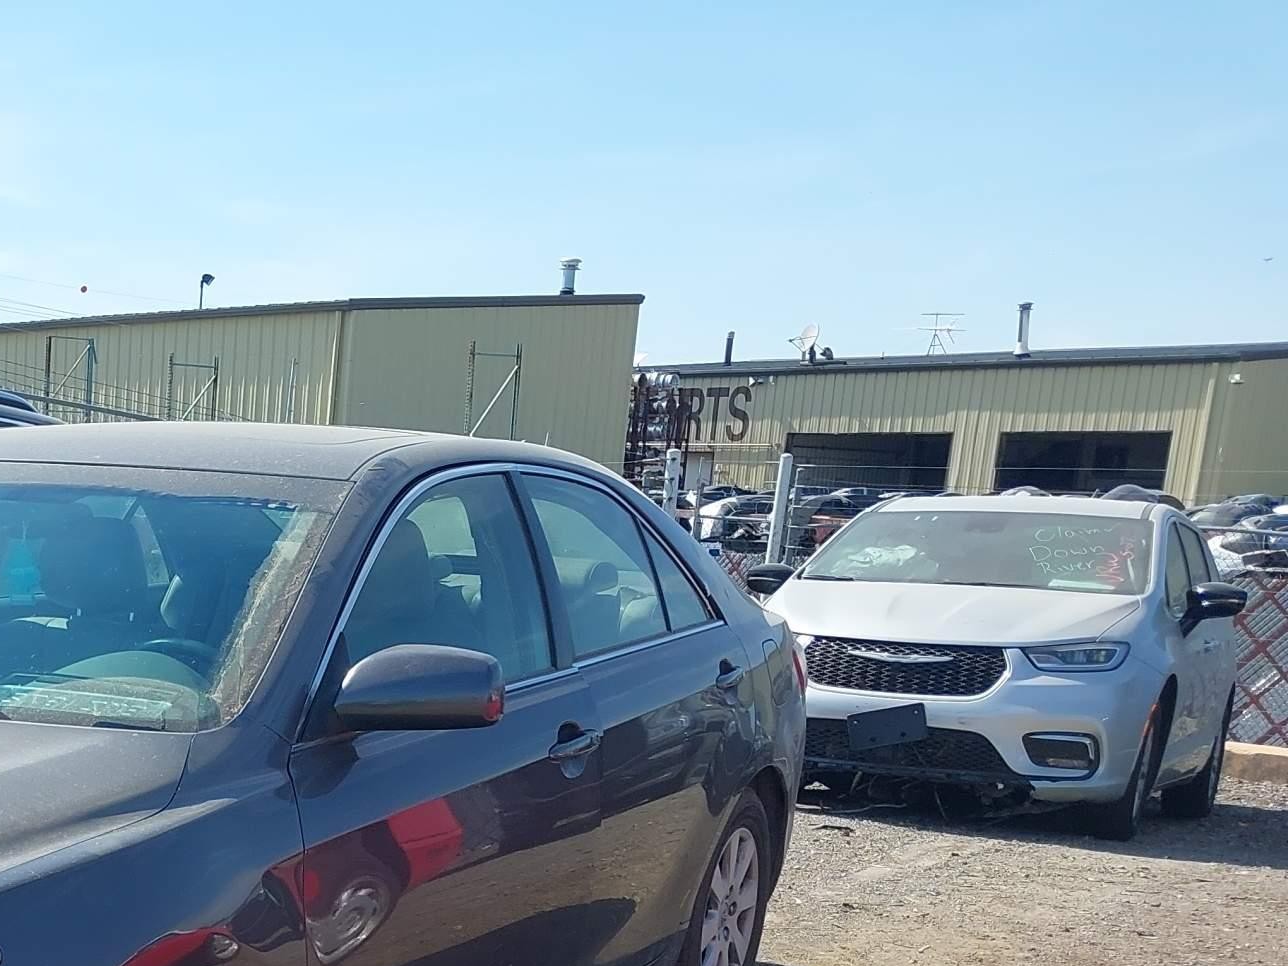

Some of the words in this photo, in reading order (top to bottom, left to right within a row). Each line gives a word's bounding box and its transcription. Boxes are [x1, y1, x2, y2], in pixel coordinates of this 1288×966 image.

[681, 386, 752, 441] RTS
[1028, 545, 1105, 561] Down
[1036, 560, 1096, 577] River
